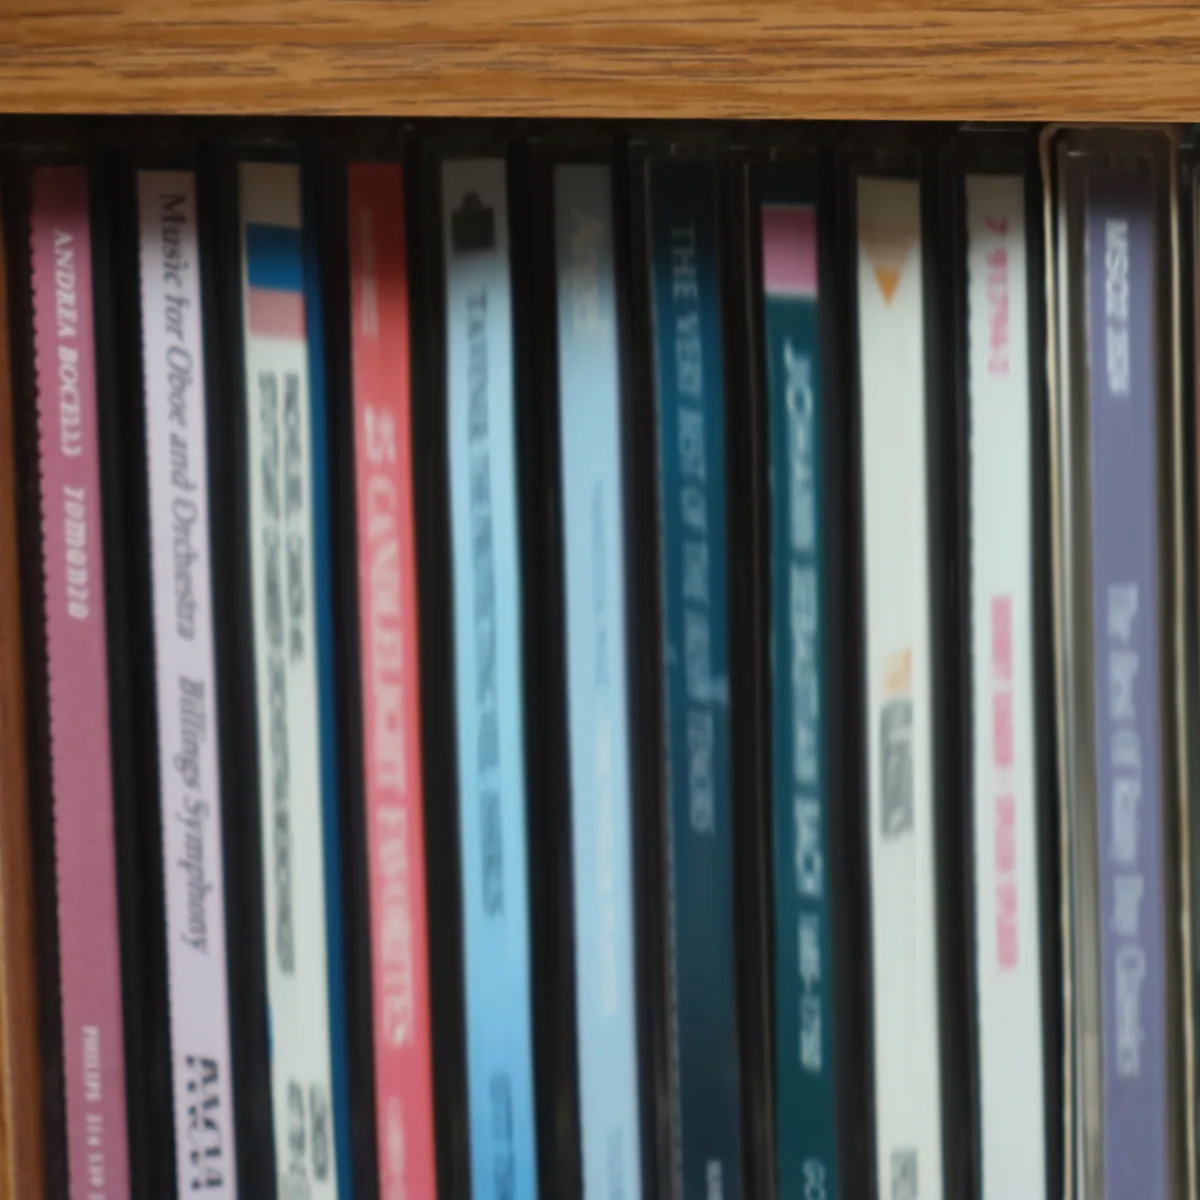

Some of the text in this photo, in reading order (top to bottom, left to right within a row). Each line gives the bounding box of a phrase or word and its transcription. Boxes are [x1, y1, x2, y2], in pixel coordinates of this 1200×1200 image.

[52, 230, 78, 338] ANDREA
[668, 221, 695, 298] THE
[158, 194, 200, 641] Music for Oboe and Orchestra
[1106, 584, 1138, 643] The
[172, 675, 212, 956] Billings Symphony
[376, 806, 412, 1048] FAVORITES
